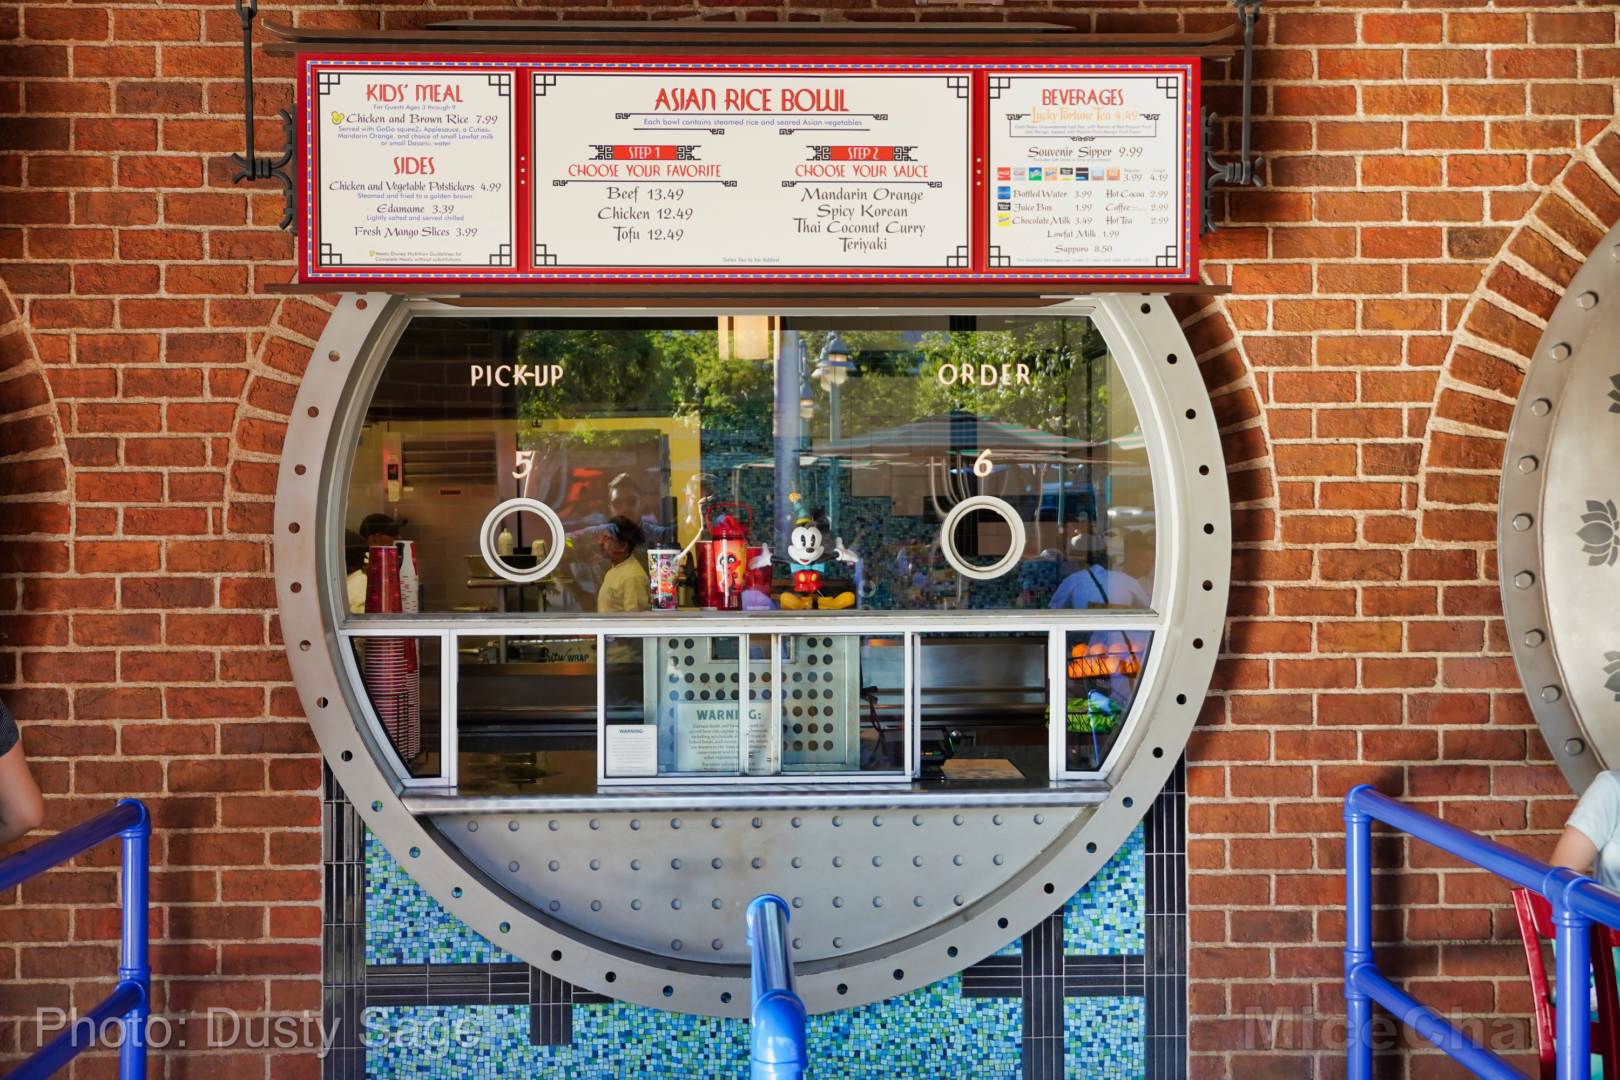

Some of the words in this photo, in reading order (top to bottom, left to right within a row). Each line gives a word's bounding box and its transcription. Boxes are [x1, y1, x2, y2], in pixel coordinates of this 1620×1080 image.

[416, 84, 463, 102] MEAL
[1042, 89, 1124, 105] BEVERAGES
[655, 88, 716, 111] ASIAN
[724, 88, 772, 111] RICE
[781, 89, 849, 112] BOWL
[346, 113, 385, 123] Chicken
[389, 113, 405, 123] and
[409, 114, 442, 123] Brown
[446, 114, 468, 124] Rice
[476, 115, 498, 124] 7.99
[662, 118, 680, 126] bowl
[714, 118, 744, 126] steamed
[746, 118, 759, 126] rice
[825, 119, 862, 128] vegetables
[628, 147, 652, 159] STEP
[655, 147, 660, 158] 1
[847, 147, 871, 160] STEP
[873, 147, 879, 160] 2
[1028, 146, 1073, 158] Souvenir
[1077, 146, 1112, 158] Sipper
[1119, 147, 1143, 157] 9.99
[394, 157, 435, 174] SIDES
[568, 164, 619, 177] CHOOSE
[625, 165, 660, 177] YOUR
[667, 165, 721, 177] FAVORITE
[795, 164, 847, 177] CHOOSE
[852, 165, 887, 177] YOUR
[893, 165, 928, 178] SAUCE
[1123, 174, 1143, 183] 3.99
[329, 181, 365, 191] Chicken
[368, 181, 383, 191] and
[386, 181, 426, 192] Vegetable
[429, 181, 475, 192] Potstickers
[481, 183, 501, 192] 4.99
[607, 186, 640, 203] Beef
[648, 189, 684, 200] 13.49
[801, 187, 868, 202] Mandarin
[873, 188, 924, 204] Orange
[1013, 190, 1040, 199] Bottled
[1041, 190, 1067, 198] Water
[1074, 190, 1092, 199] 3.99
[1106, 189, 1119, 199] Hot
[1120, 190, 1144, 198] Cocoa
[1150, 190, 1168, 200] 2.99
[377, 203, 424, 213] Edamame
[432, 205, 454, 214] 3.39
[598, 206, 650, 219] Chicken
[657, 208, 693, 220] 12.49
[817, 204, 854, 220] Spicy
[861, 204, 908, 218] Korean
[1013, 203, 1034, 213] Juice
[1012, 216, 1049, 225] Chocolate
[1050, 217, 1070, 225] Milk
[1075, 216, 1093, 225] 3.49
[1105, 216, 1119, 224] Hot
[354, 226, 381, 236] Fresh
[384, 227, 419, 239] Mango
[421, 227, 450, 237] Slices
[456, 228, 477, 237] 3.99
[793, 218, 820, 233] Thai
[827, 221, 879, 233] Coconut
[885, 221, 925, 237] Curry
[1047, 230, 1073, 239] Lowfat
[1076, 229, 1096, 239] Milk
[613, 226, 640, 243] Tofu
[648, 229, 683, 241] 12.49
[838, 237, 886, 253] Teriyaki
[470, 364, 564, 387] PICK-UP
[938, 363, 1030, 386] ORDER
[512, 450, 534, 479] 5
[973, 448, 993, 477] 6
[696, 709, 762, 721] WARNIG:
